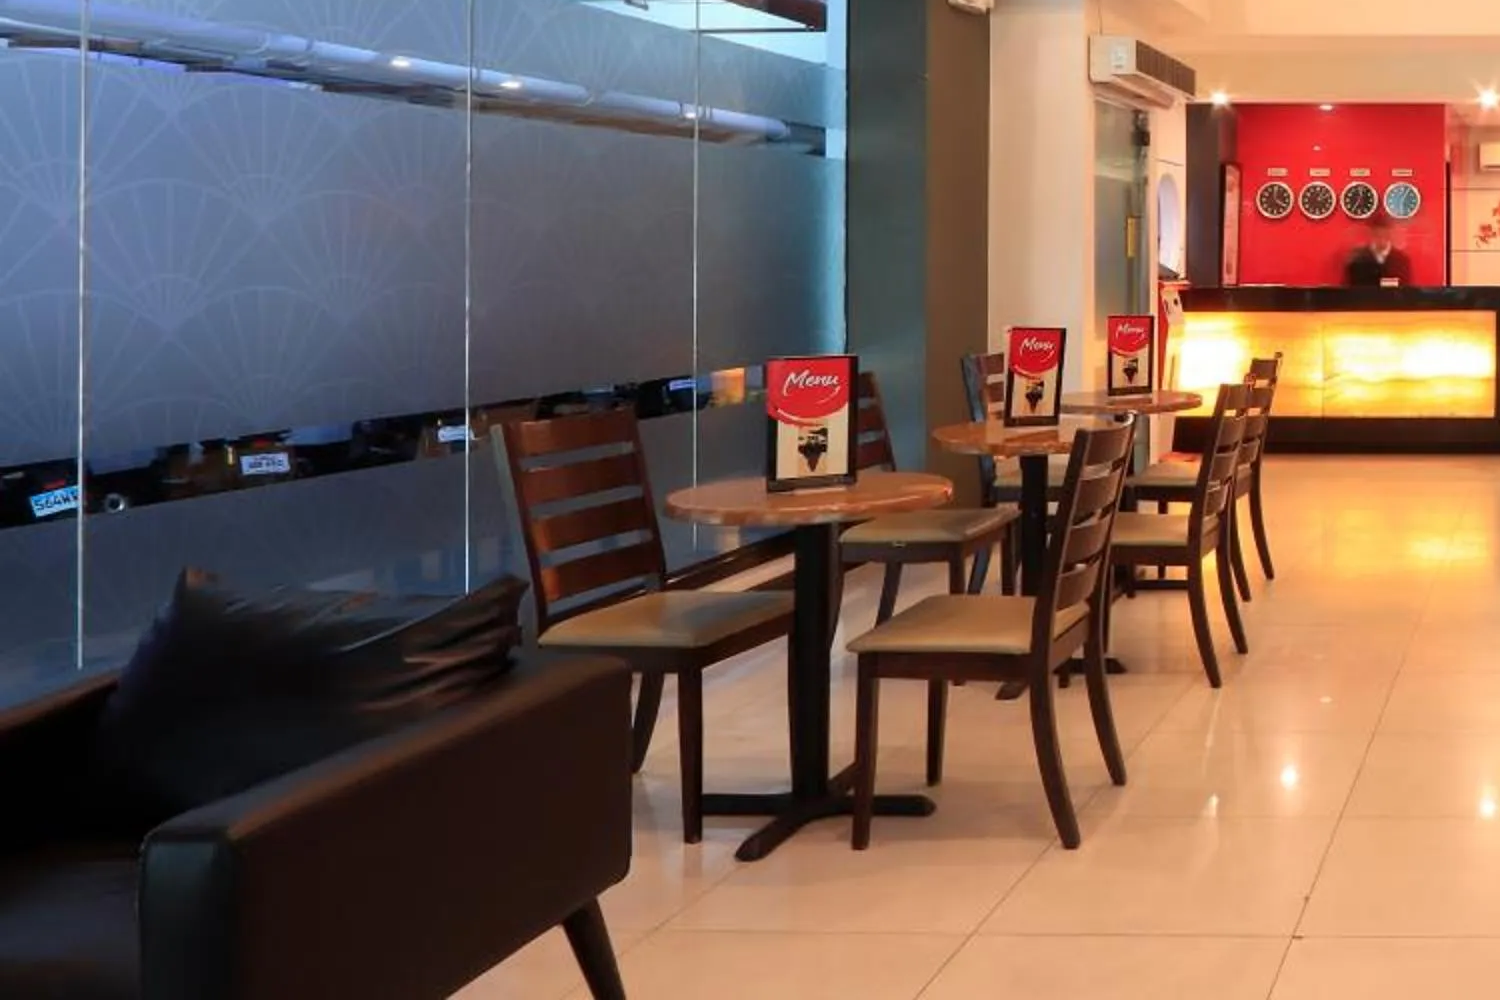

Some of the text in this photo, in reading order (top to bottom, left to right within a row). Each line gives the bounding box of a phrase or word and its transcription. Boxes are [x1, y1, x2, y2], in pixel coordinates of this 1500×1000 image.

[1115, 323, 1144, 340] Menu
[1019, 336, 1054, 357] Menu
[782, 369, 840, 397] Menu
